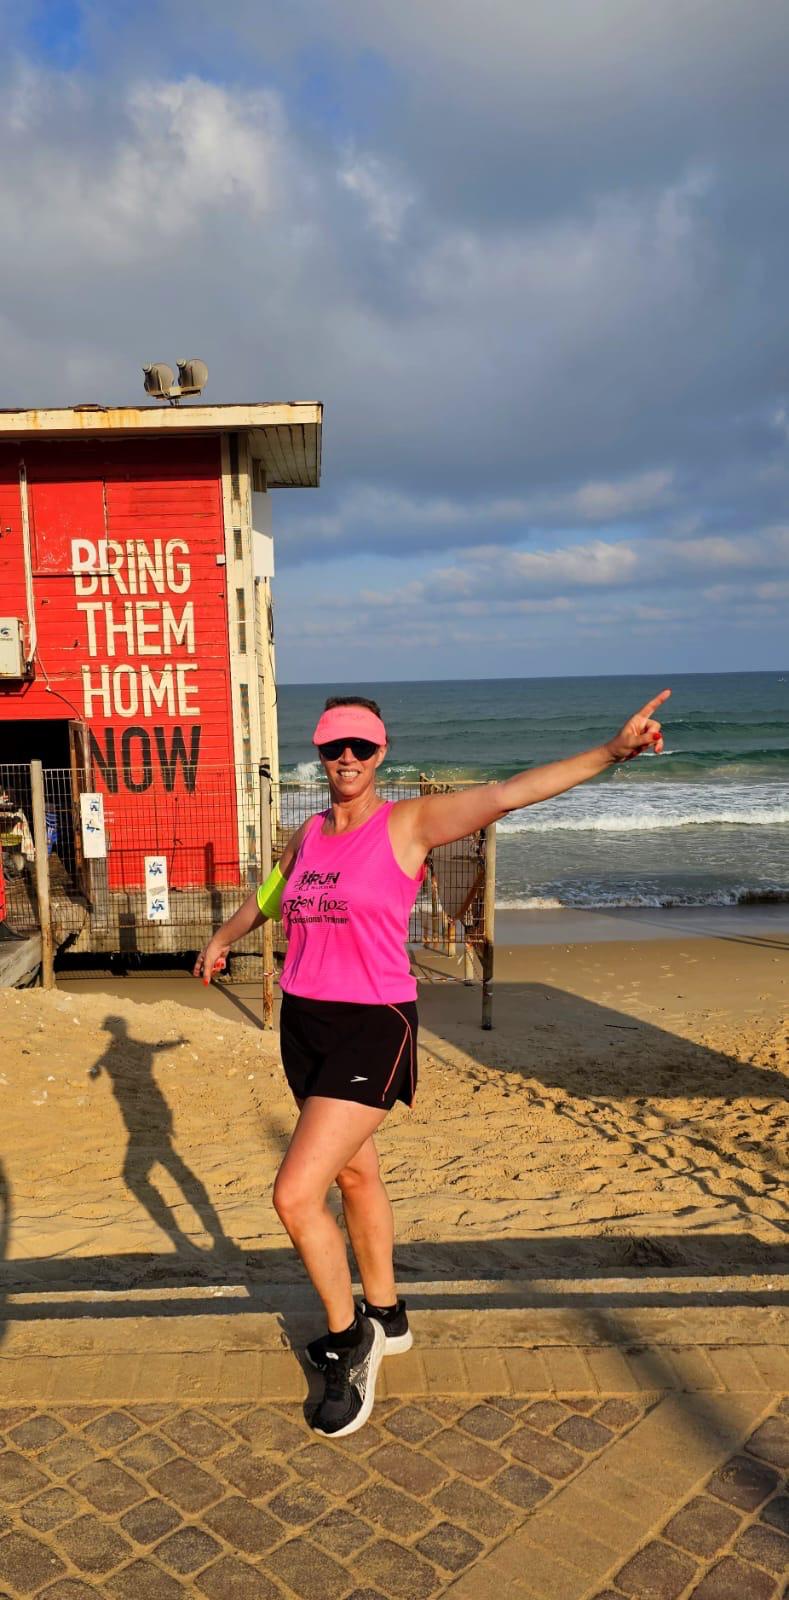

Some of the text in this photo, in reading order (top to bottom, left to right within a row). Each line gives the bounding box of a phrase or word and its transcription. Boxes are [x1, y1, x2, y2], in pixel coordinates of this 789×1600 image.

[71, 538, 191, 596] BRING
[76, 600, 195, 657] THEM
[81, 663, 200, 718] HOME
[88, 725, 201, 793] NOW
